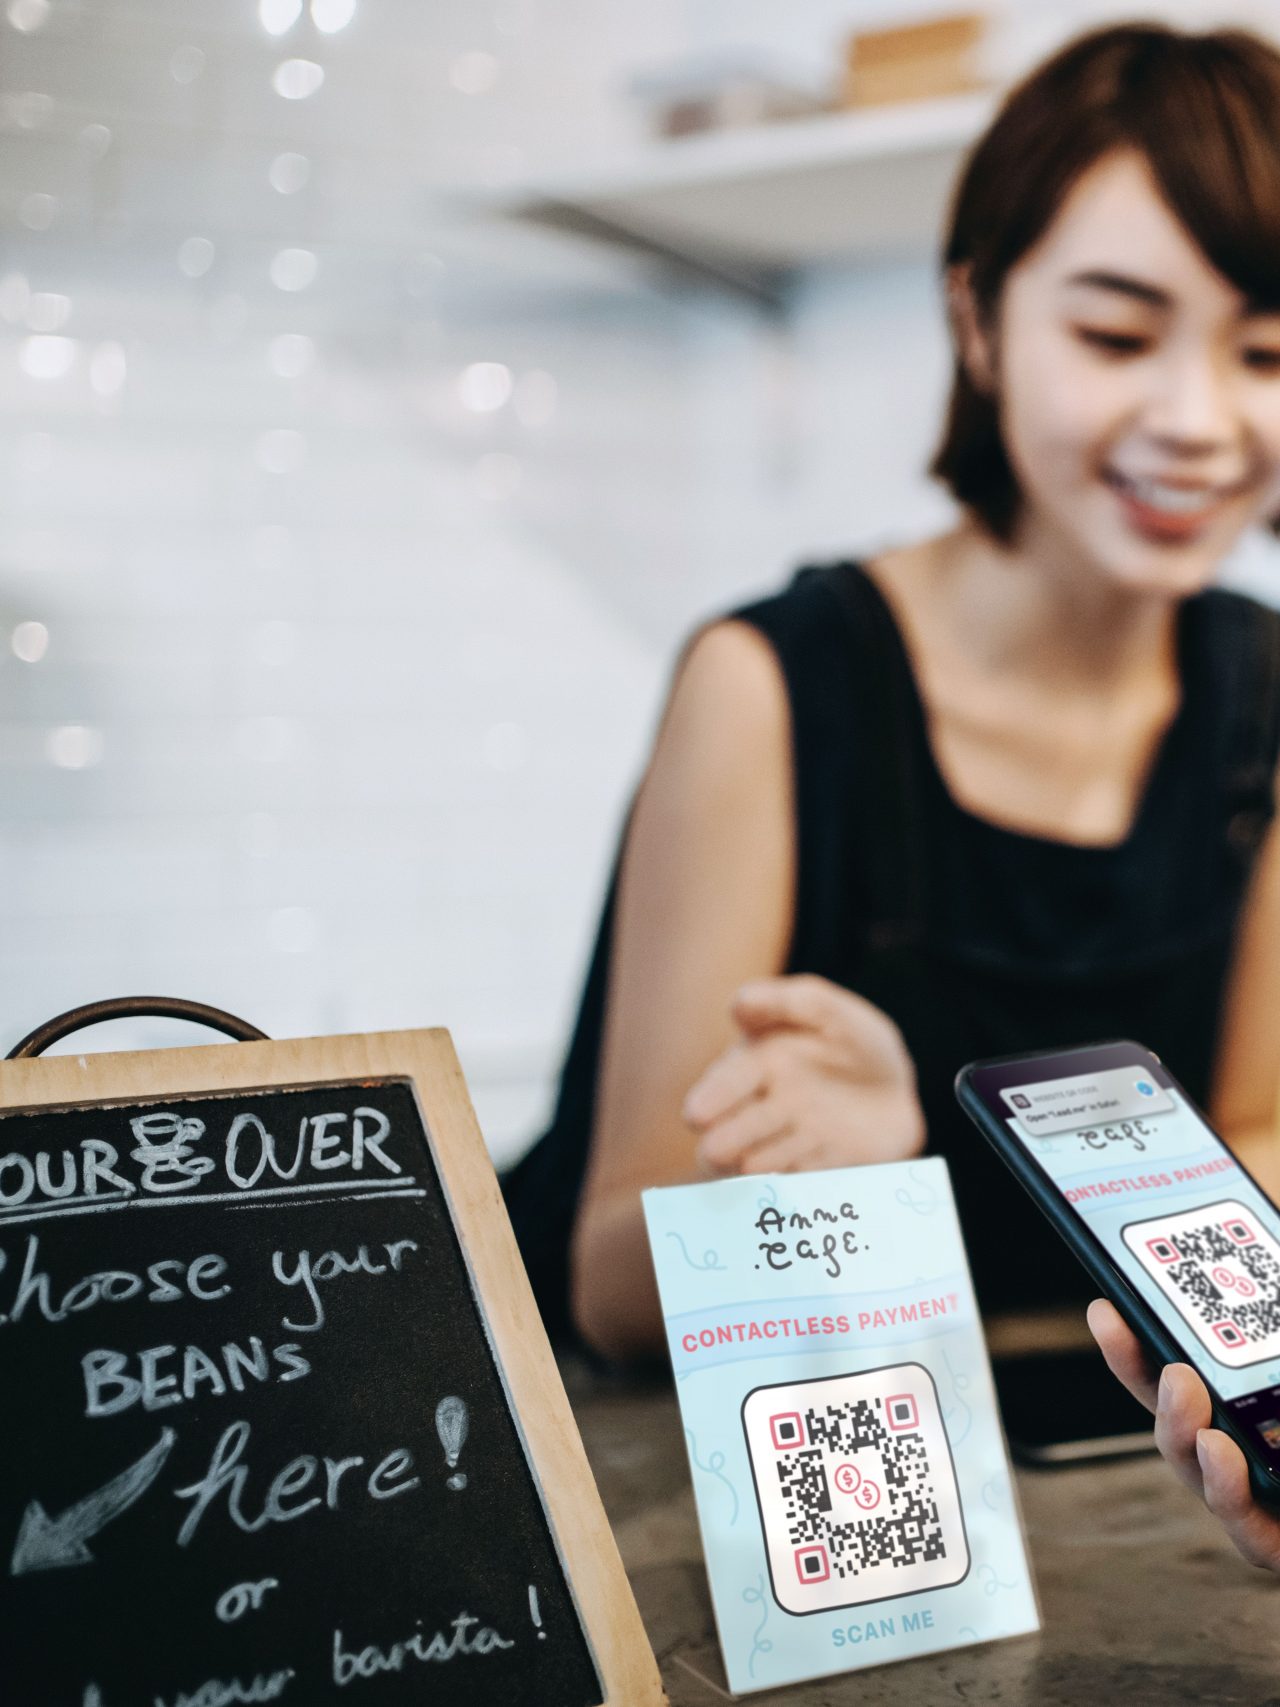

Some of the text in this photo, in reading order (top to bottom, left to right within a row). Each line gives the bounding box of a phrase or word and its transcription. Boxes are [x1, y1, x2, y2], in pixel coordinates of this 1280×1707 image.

[225, 1106, 402, 1190] OVER
[1065, 1172, 1173, 1203] ONTACTLESS
[755, 1202, 859, 1235] Anna
[0, 1233, 418, 1332] hoose your
[681, 1292, 960, 1353] CONTACTLESS PAYMENT
[81, 1337, 312, 1418] BEANS
[215, 1579, 278, 1623] or
[831, 1609, 935, 1648] SCAN ME
